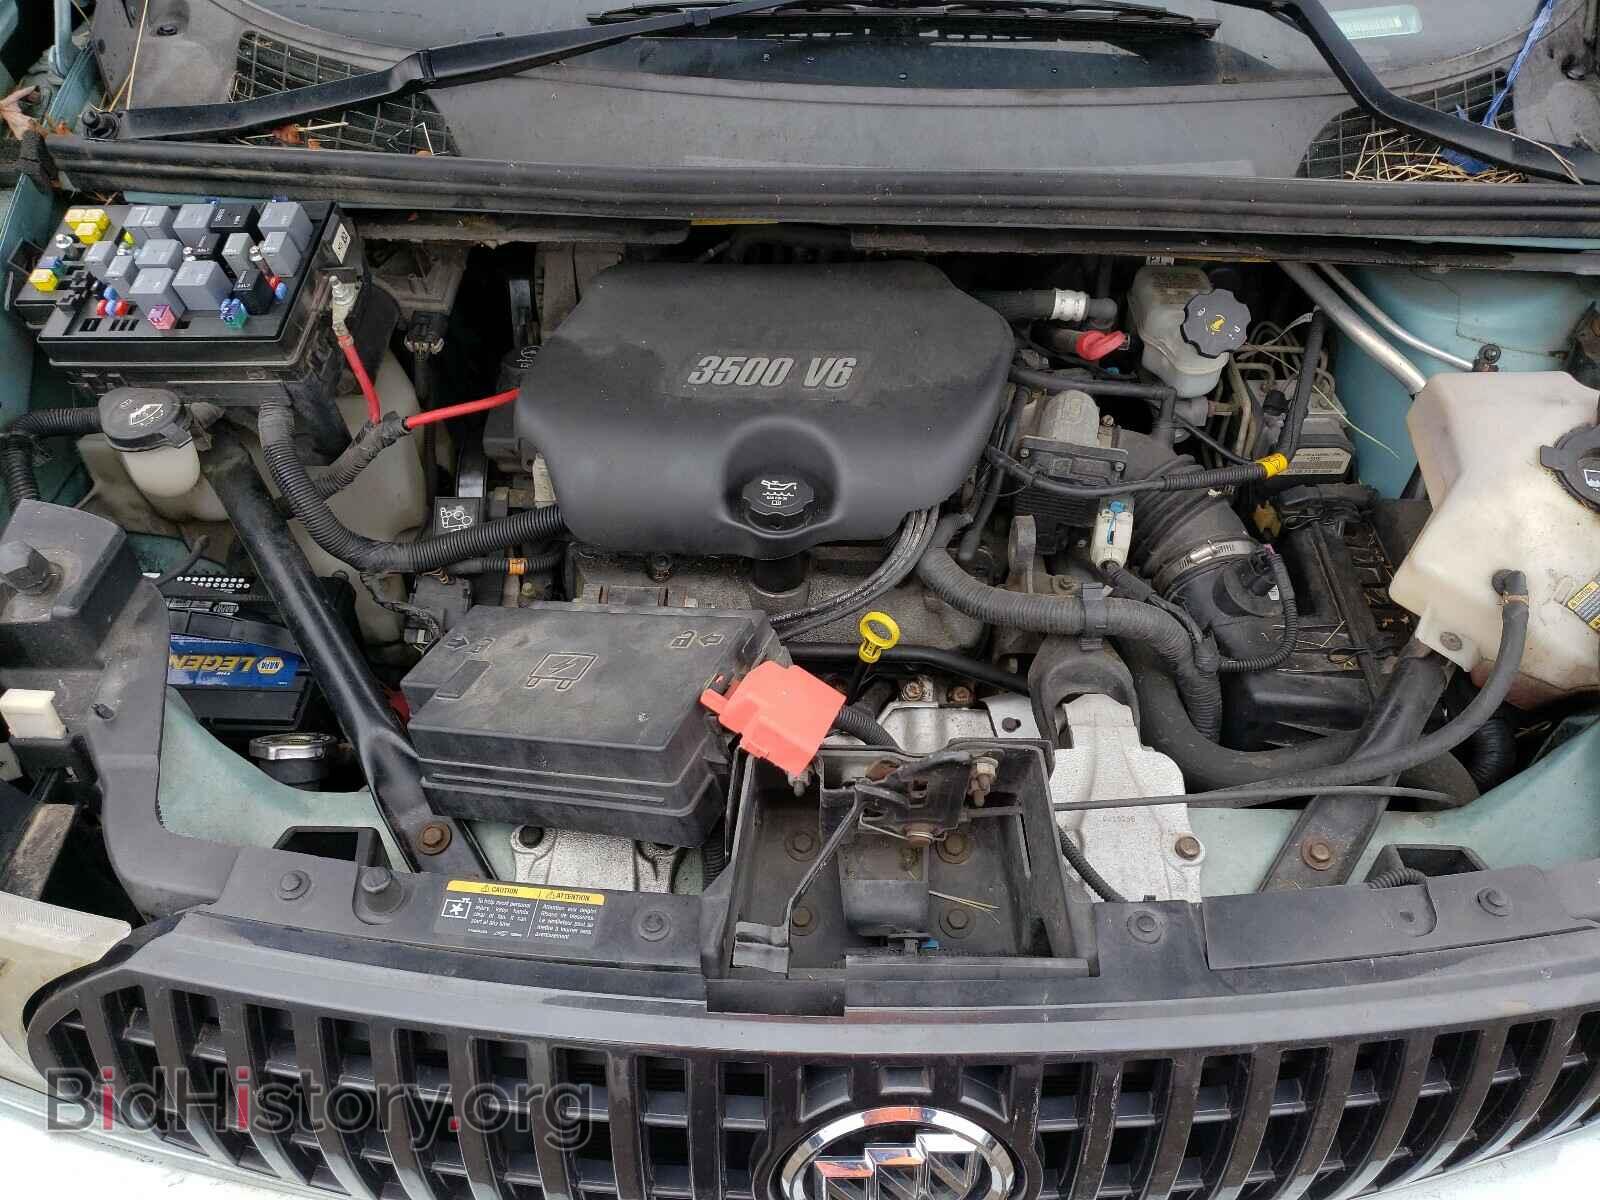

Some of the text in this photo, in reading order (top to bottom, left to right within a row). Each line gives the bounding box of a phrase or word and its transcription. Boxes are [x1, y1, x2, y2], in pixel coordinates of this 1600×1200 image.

[687, 355, 857, 388] 3500 V6
[491, 886, 519, 895] CAUTION
[556, 892, 592, 901] ATTENTION
